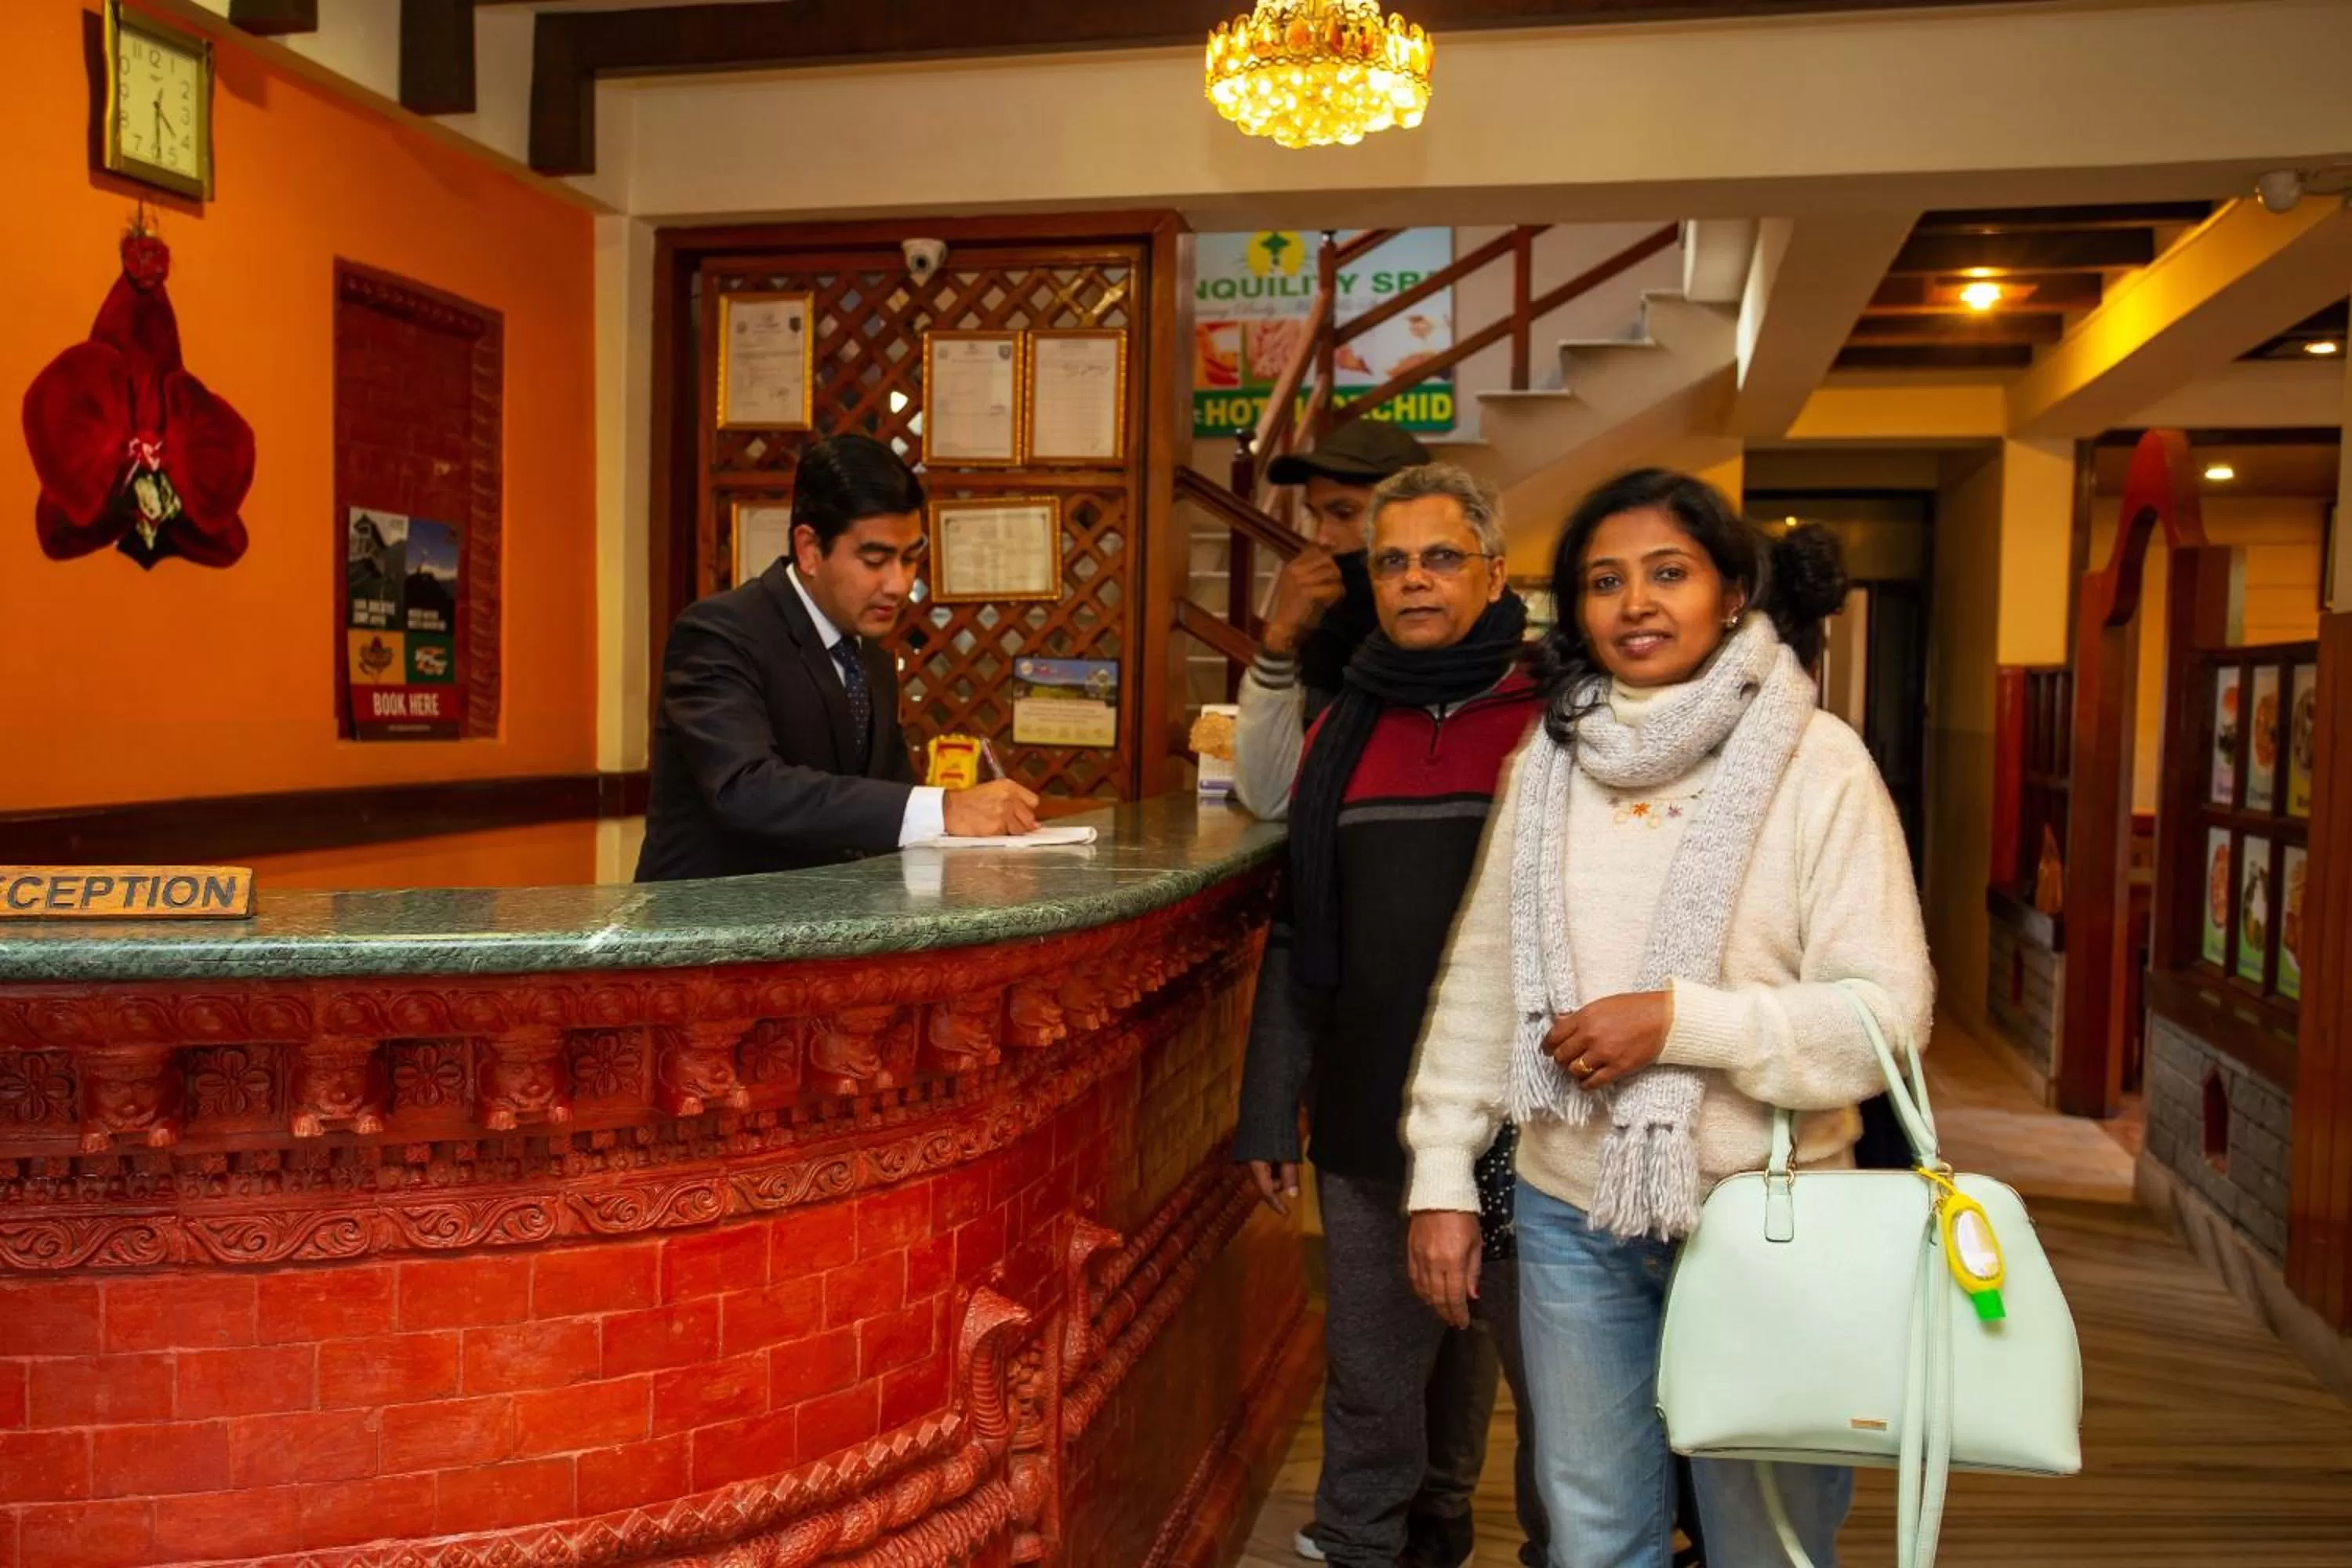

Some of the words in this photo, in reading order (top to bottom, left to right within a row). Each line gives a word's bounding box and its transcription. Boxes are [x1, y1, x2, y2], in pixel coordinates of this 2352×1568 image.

[132, 42, 143, 59] 11
[180, 81, 190, 100] 2
[180, 108, 191, 125] 3
[132, 134, 143, 151] 7
[180, 135, 191, 149] 4
[167, 145, 177, 166] 5
[1196, 273, 1359, 299] NQUILIY
[1372, 270, 1437, 293] SP
[372, 691, 406, 716] BOOK
[408, 692, 440, 716] HERE
[0, 876, 237, 909] CEPTION
